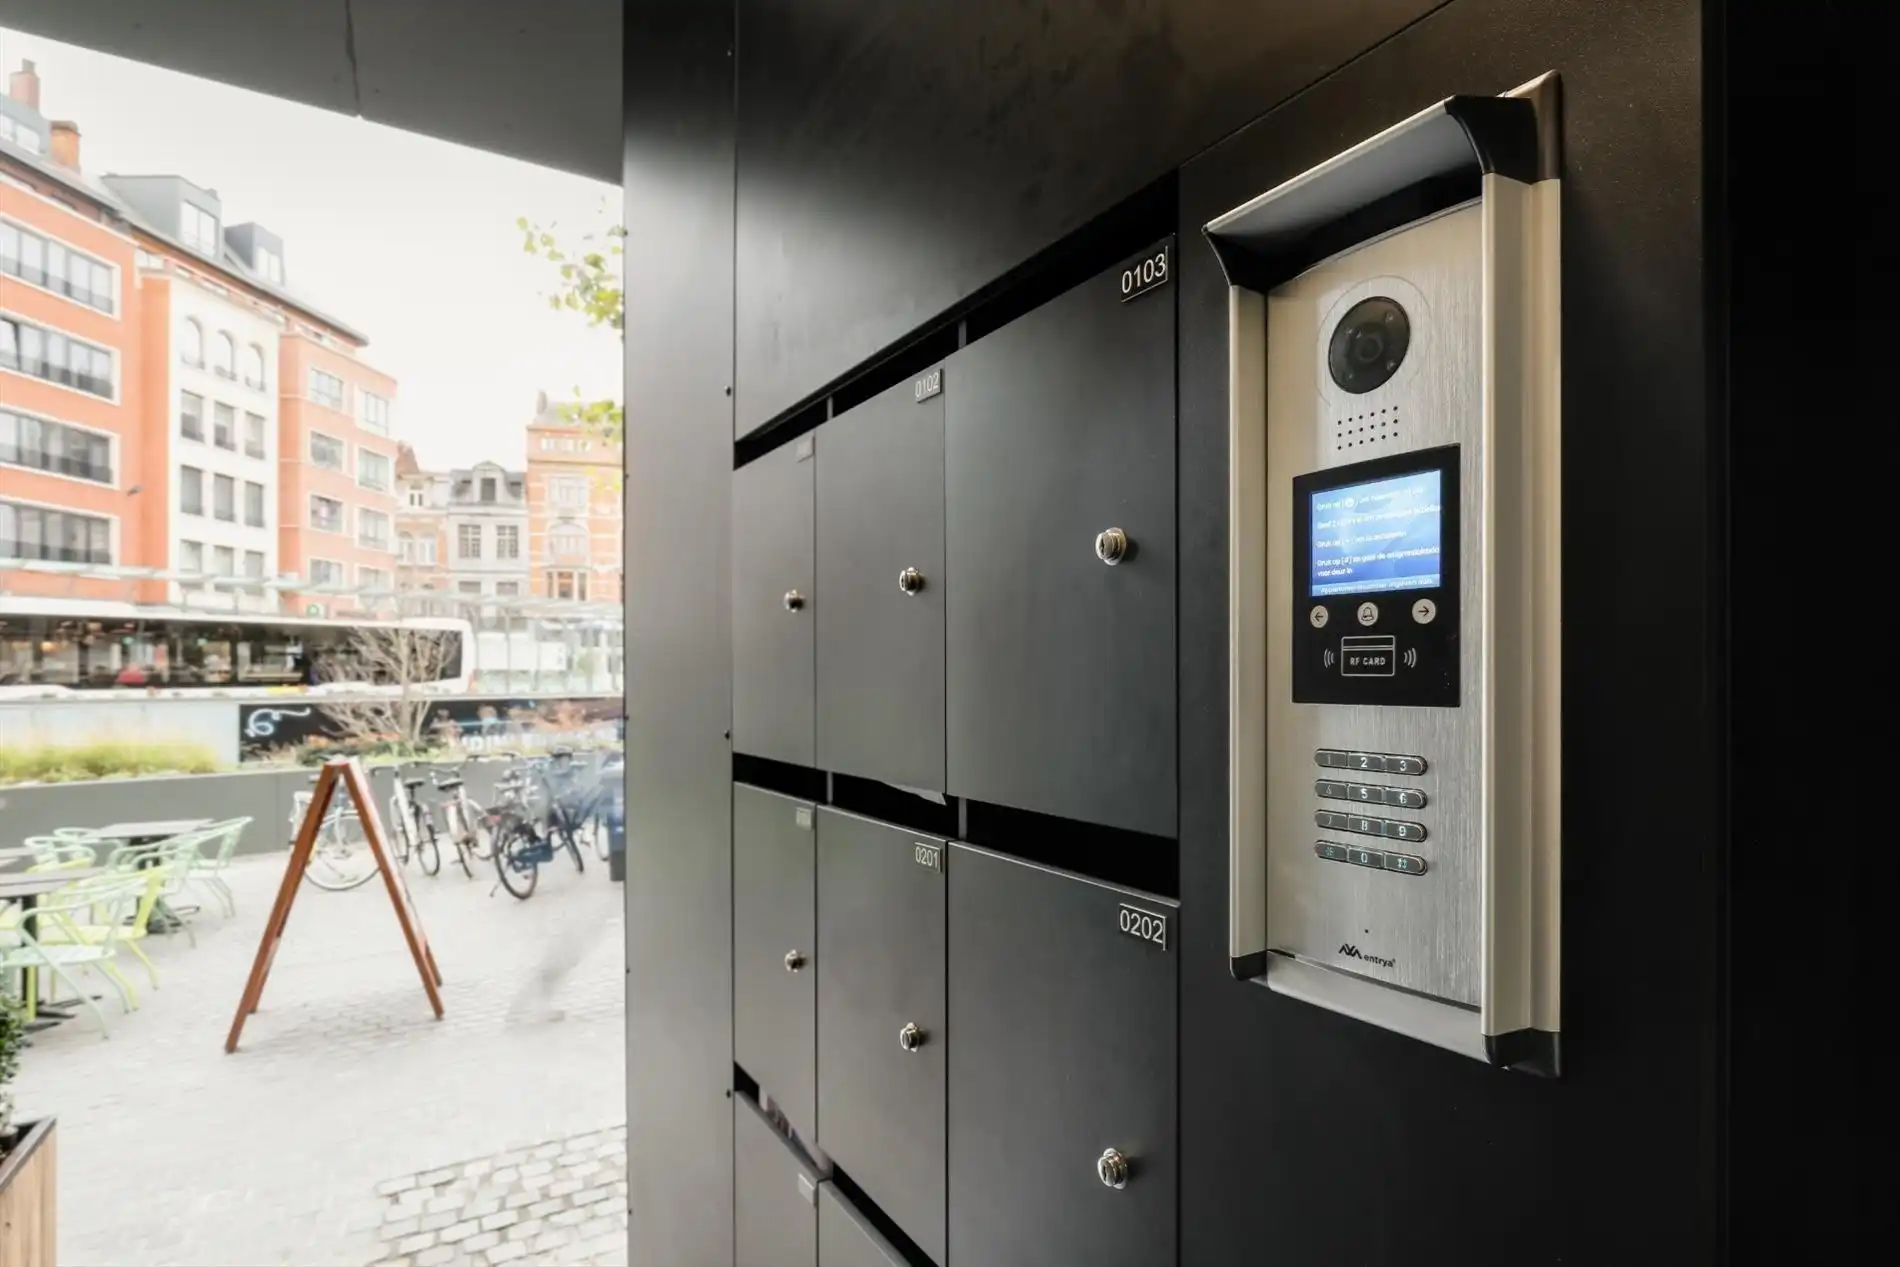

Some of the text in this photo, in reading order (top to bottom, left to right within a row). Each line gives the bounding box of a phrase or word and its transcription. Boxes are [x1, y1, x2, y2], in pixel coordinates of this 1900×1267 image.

[1122, 253, 1166, 294] 0103
[915, 372, 938, 398] 0102
[1350, 656, 1386, 666] RF CARD
[1360, 757, 1368, 768] 2
[1400, 760, 1407, 772] 3
[1360, 788, 1368, 799] 5
[1400, 792, 1407, 804] 6
[1399, 826, 1406, 836] 9
[916, 846, 938, 868] 0201
[1361, 852, 1368, 863] 0
[1120, 910, 1164, 943] 0202
